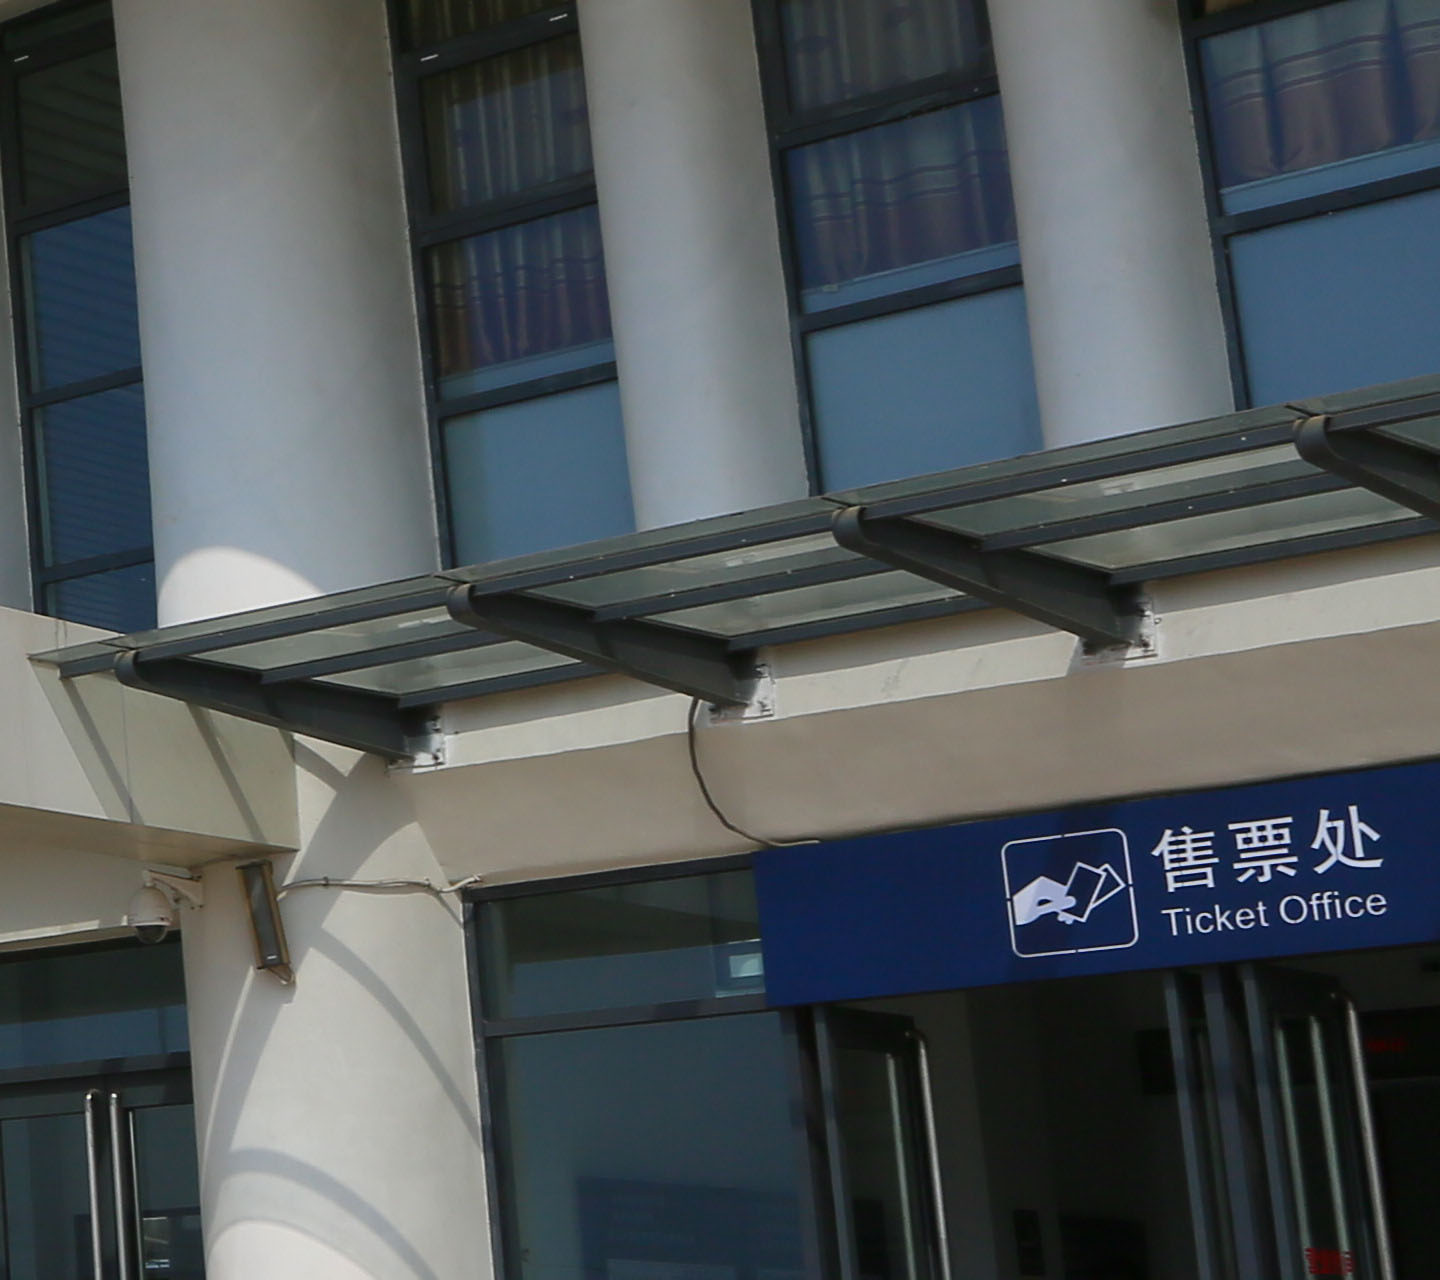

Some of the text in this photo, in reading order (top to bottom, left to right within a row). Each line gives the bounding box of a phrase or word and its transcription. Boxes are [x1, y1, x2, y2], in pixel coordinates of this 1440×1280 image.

[1151, 805, 1384, 892] 售票处
[1161, 891, 1387, 936] Ticket Office
